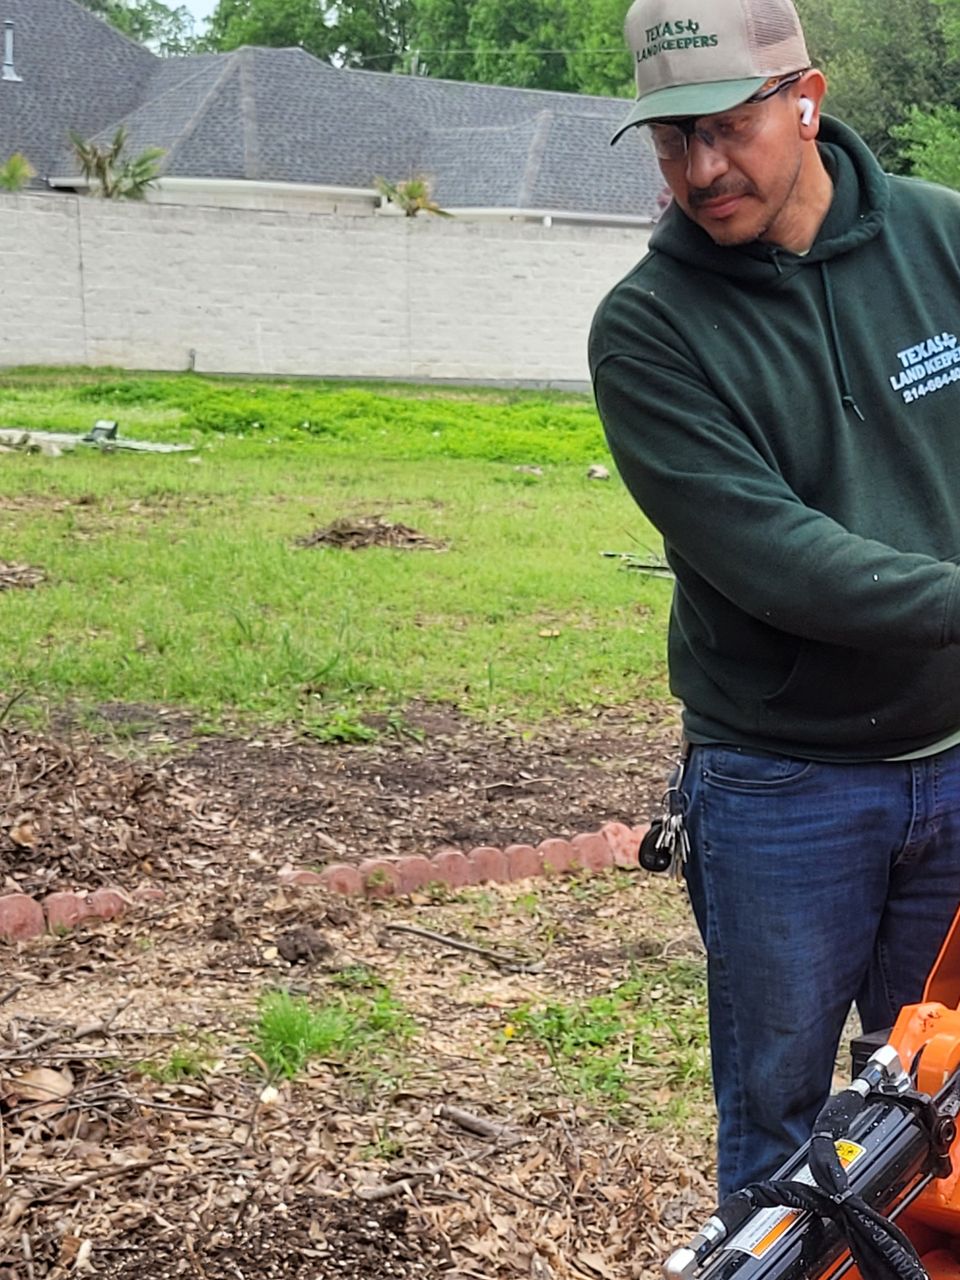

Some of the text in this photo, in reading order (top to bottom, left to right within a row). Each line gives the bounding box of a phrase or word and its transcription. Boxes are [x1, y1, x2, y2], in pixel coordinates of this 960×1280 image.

[645, 21, 685, 43] TEXAS
[896, 335, 944, 368] TEXAS
[890, 364, 926, 391] LAND
